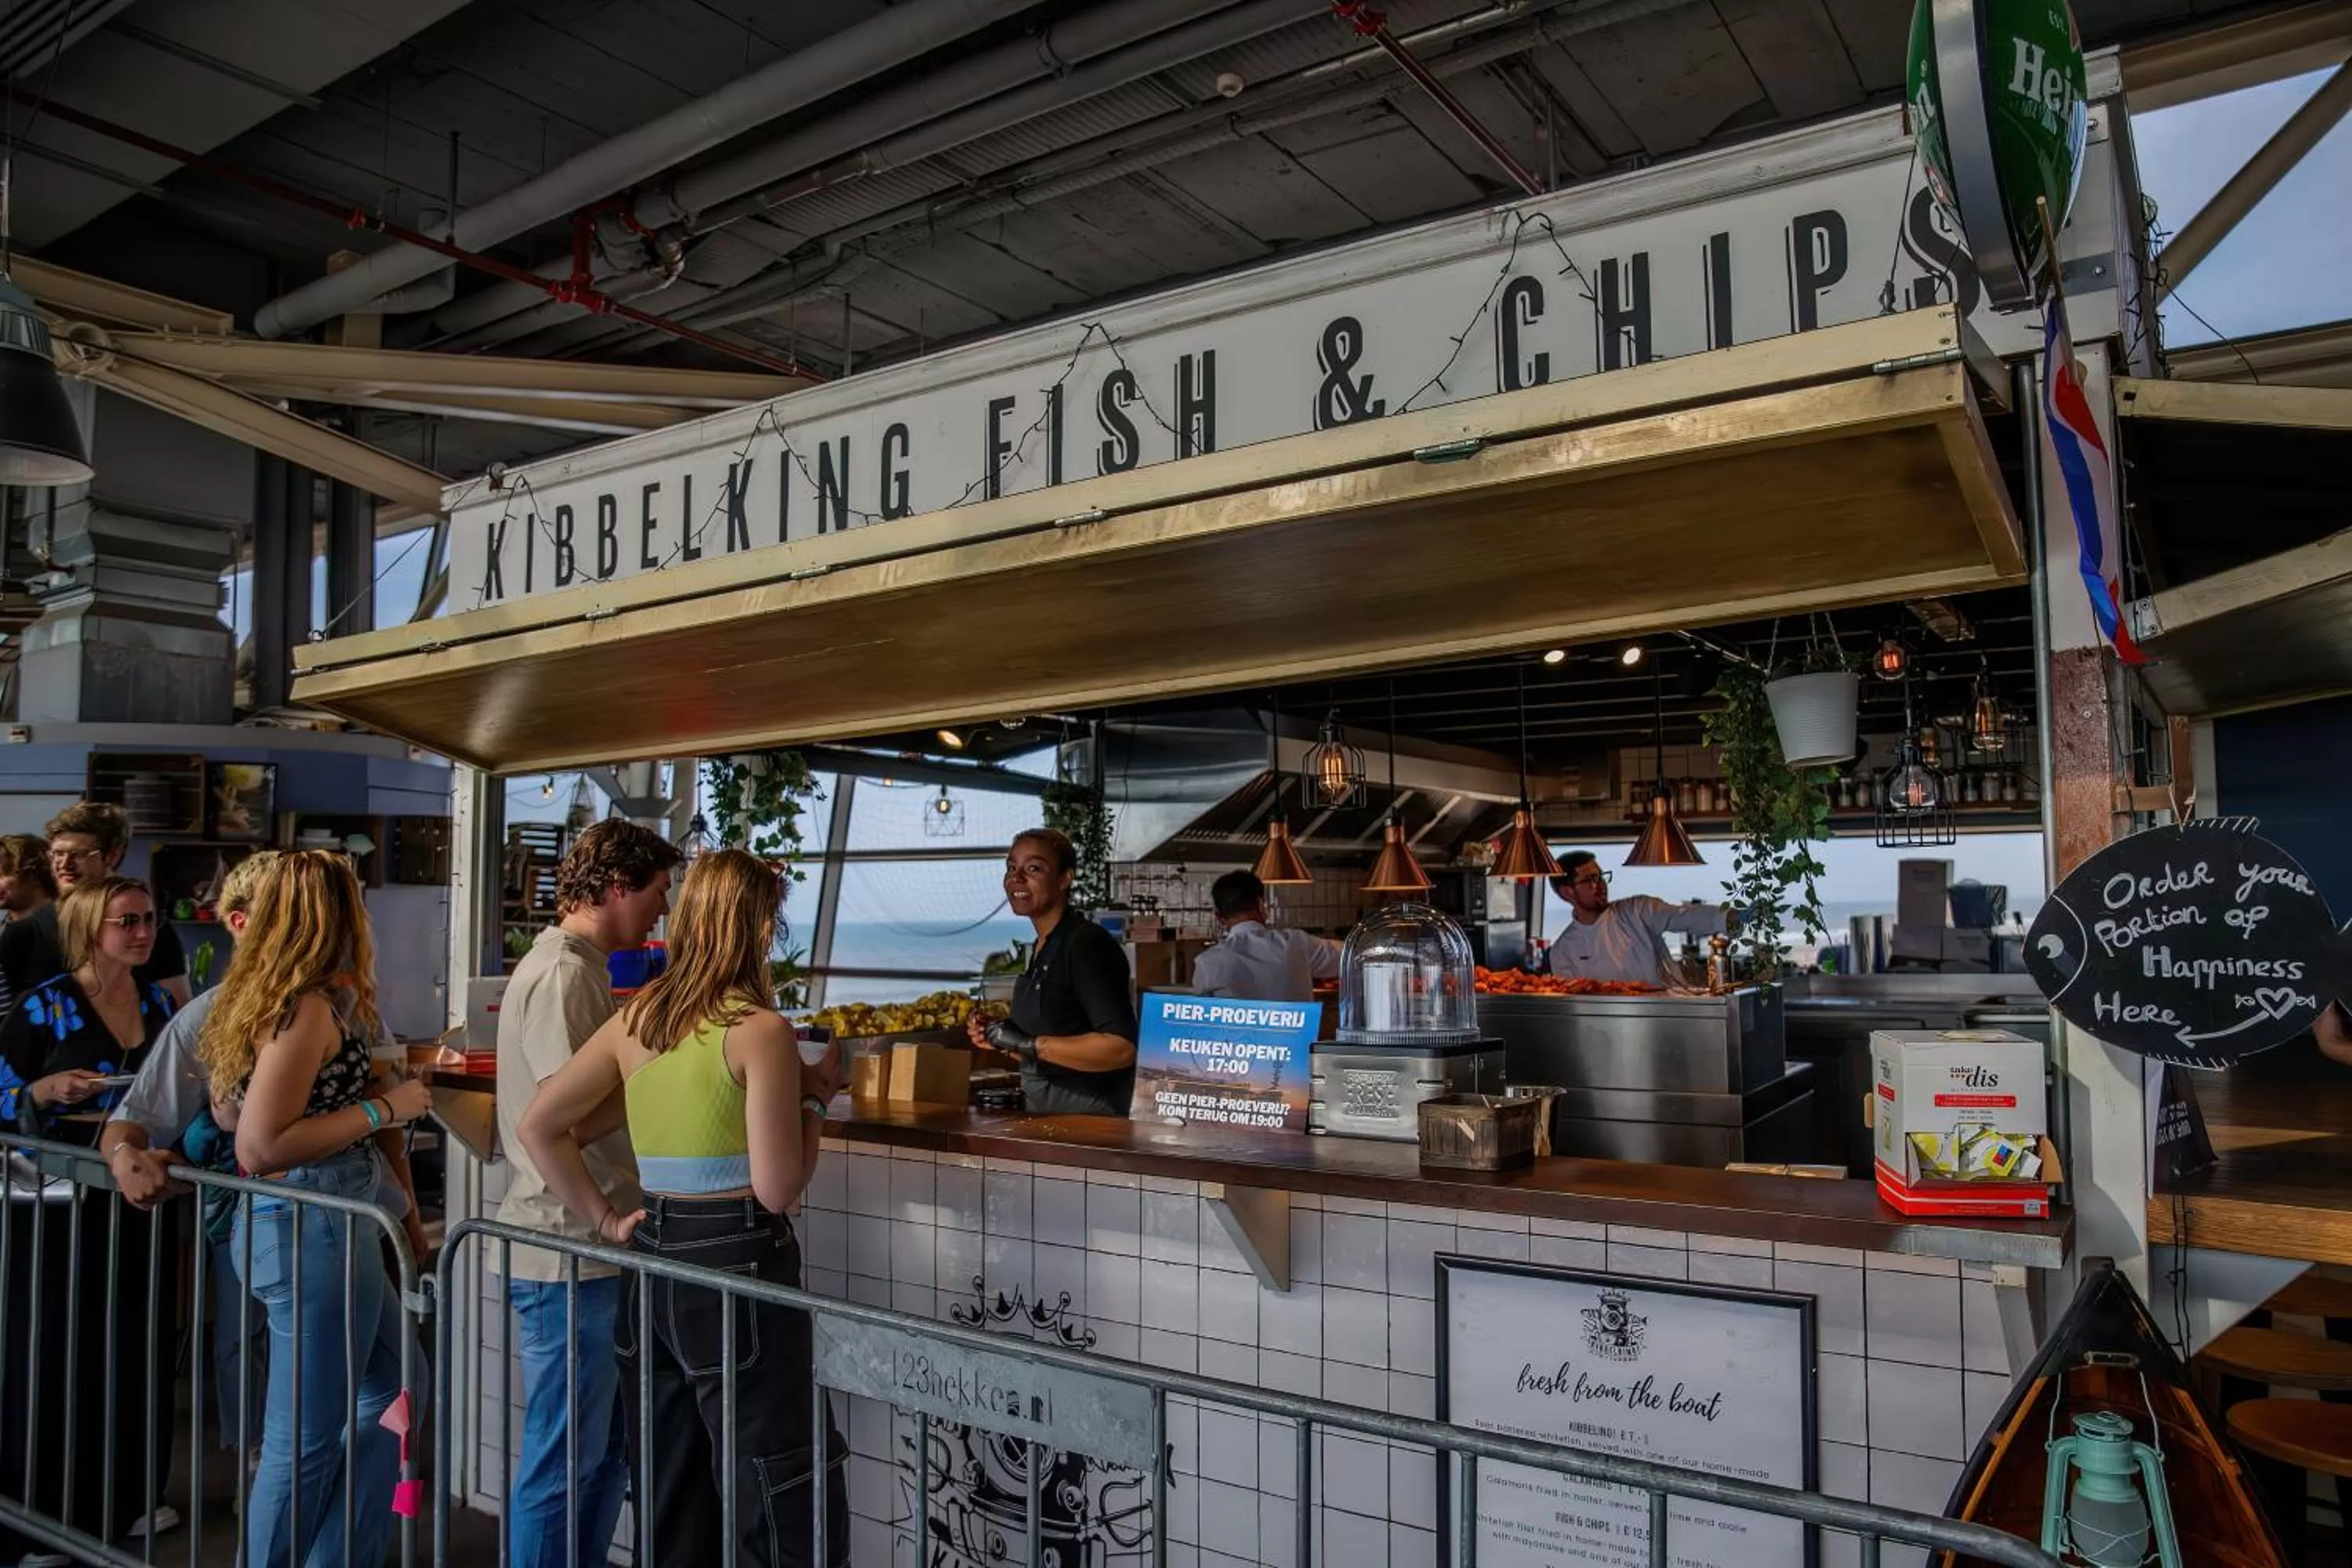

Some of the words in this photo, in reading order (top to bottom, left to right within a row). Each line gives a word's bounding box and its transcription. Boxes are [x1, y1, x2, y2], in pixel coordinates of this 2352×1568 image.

[485, 422, 911, 601] KIBBELKING
[984, 348, 1217, 500] FISH
[1314, 314, 1385, 431] &
[1494, 185, 1980, 394] CHIPS
[2103, 862, 2215, 909] Order
[2235, 862, 2315, 903] your
[2094, 906, 2207, 956] Portion
[2224, 906, 2270, 939] of
[2142, 945, 2306, 990] Happiness
[1162, 1003, 1305, 1028] PIER-PROEVERIJ
[2094, 990, 2181, 1025] Here
[1170, 1038, 1232, 1057] KEUKEN
[1235, 1044, 1291, 1061] OPENT:
[1207, 1058, 1249, 1075] 17:00
[1965, 1065, 1998, 1087] dis
[1155, 1091, 1187, 1105] GEEN
[1189, 1093, 1290, 1115] PIER-PROEVERIJ?
[1157, 1104, 1187, 1118] KOM
[1189, 1107, 1228, 1123] TERUG
[1229, 1112, 1249, 1125] OM
[1250, 1115, 1283, 1128] 19:00
[1517, 1361, 1570, 1396] fresh
[1573, 1372, 1624, 1403] from
[1628, 1374, 1663, 1410] the
[1668, 1382, 1722, 1421] boat
